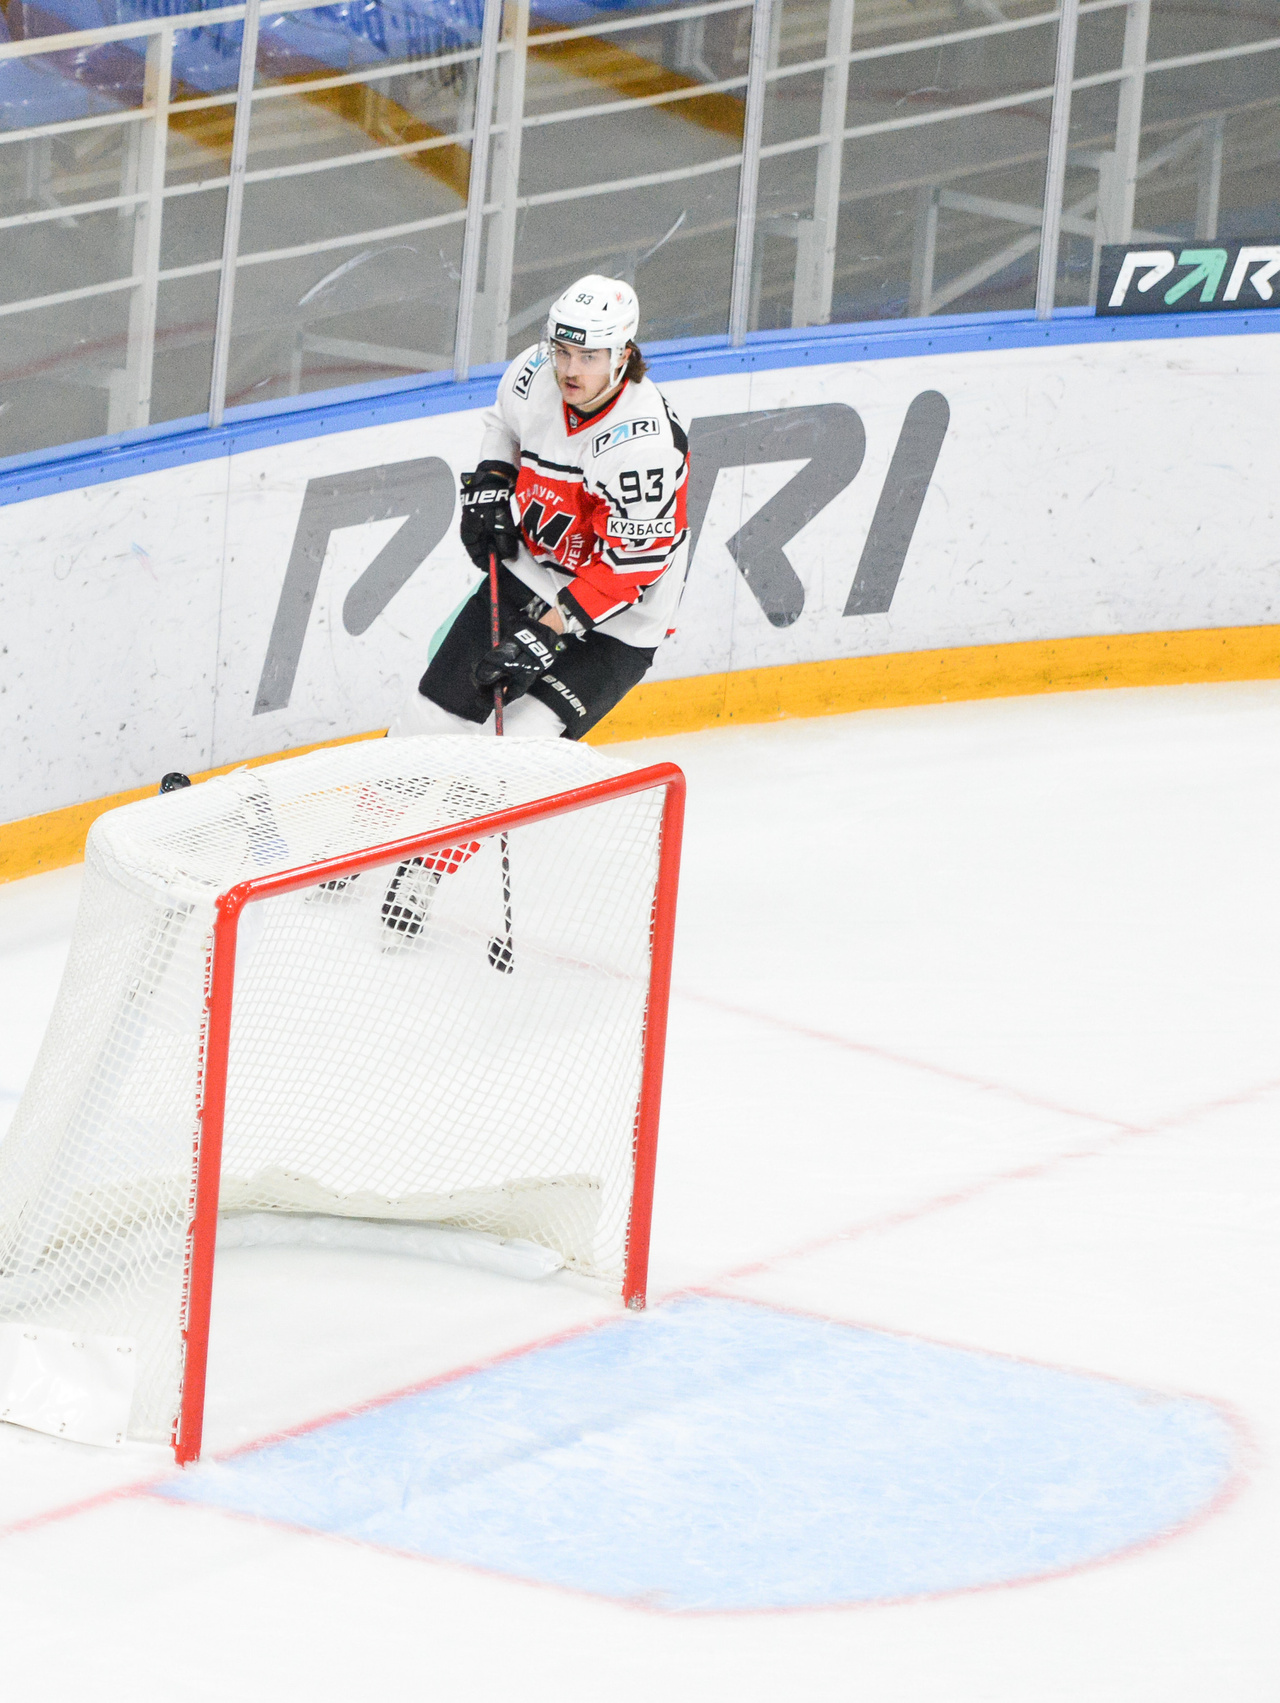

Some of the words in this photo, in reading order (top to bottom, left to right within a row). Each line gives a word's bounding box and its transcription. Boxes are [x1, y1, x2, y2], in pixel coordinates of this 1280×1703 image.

[575, 293, 594, 306] 93
[595, 420, 657, 453] PARI
[619, 467, 664, 505] 93
[609, 520, 673, 537] КУЗБАСС
